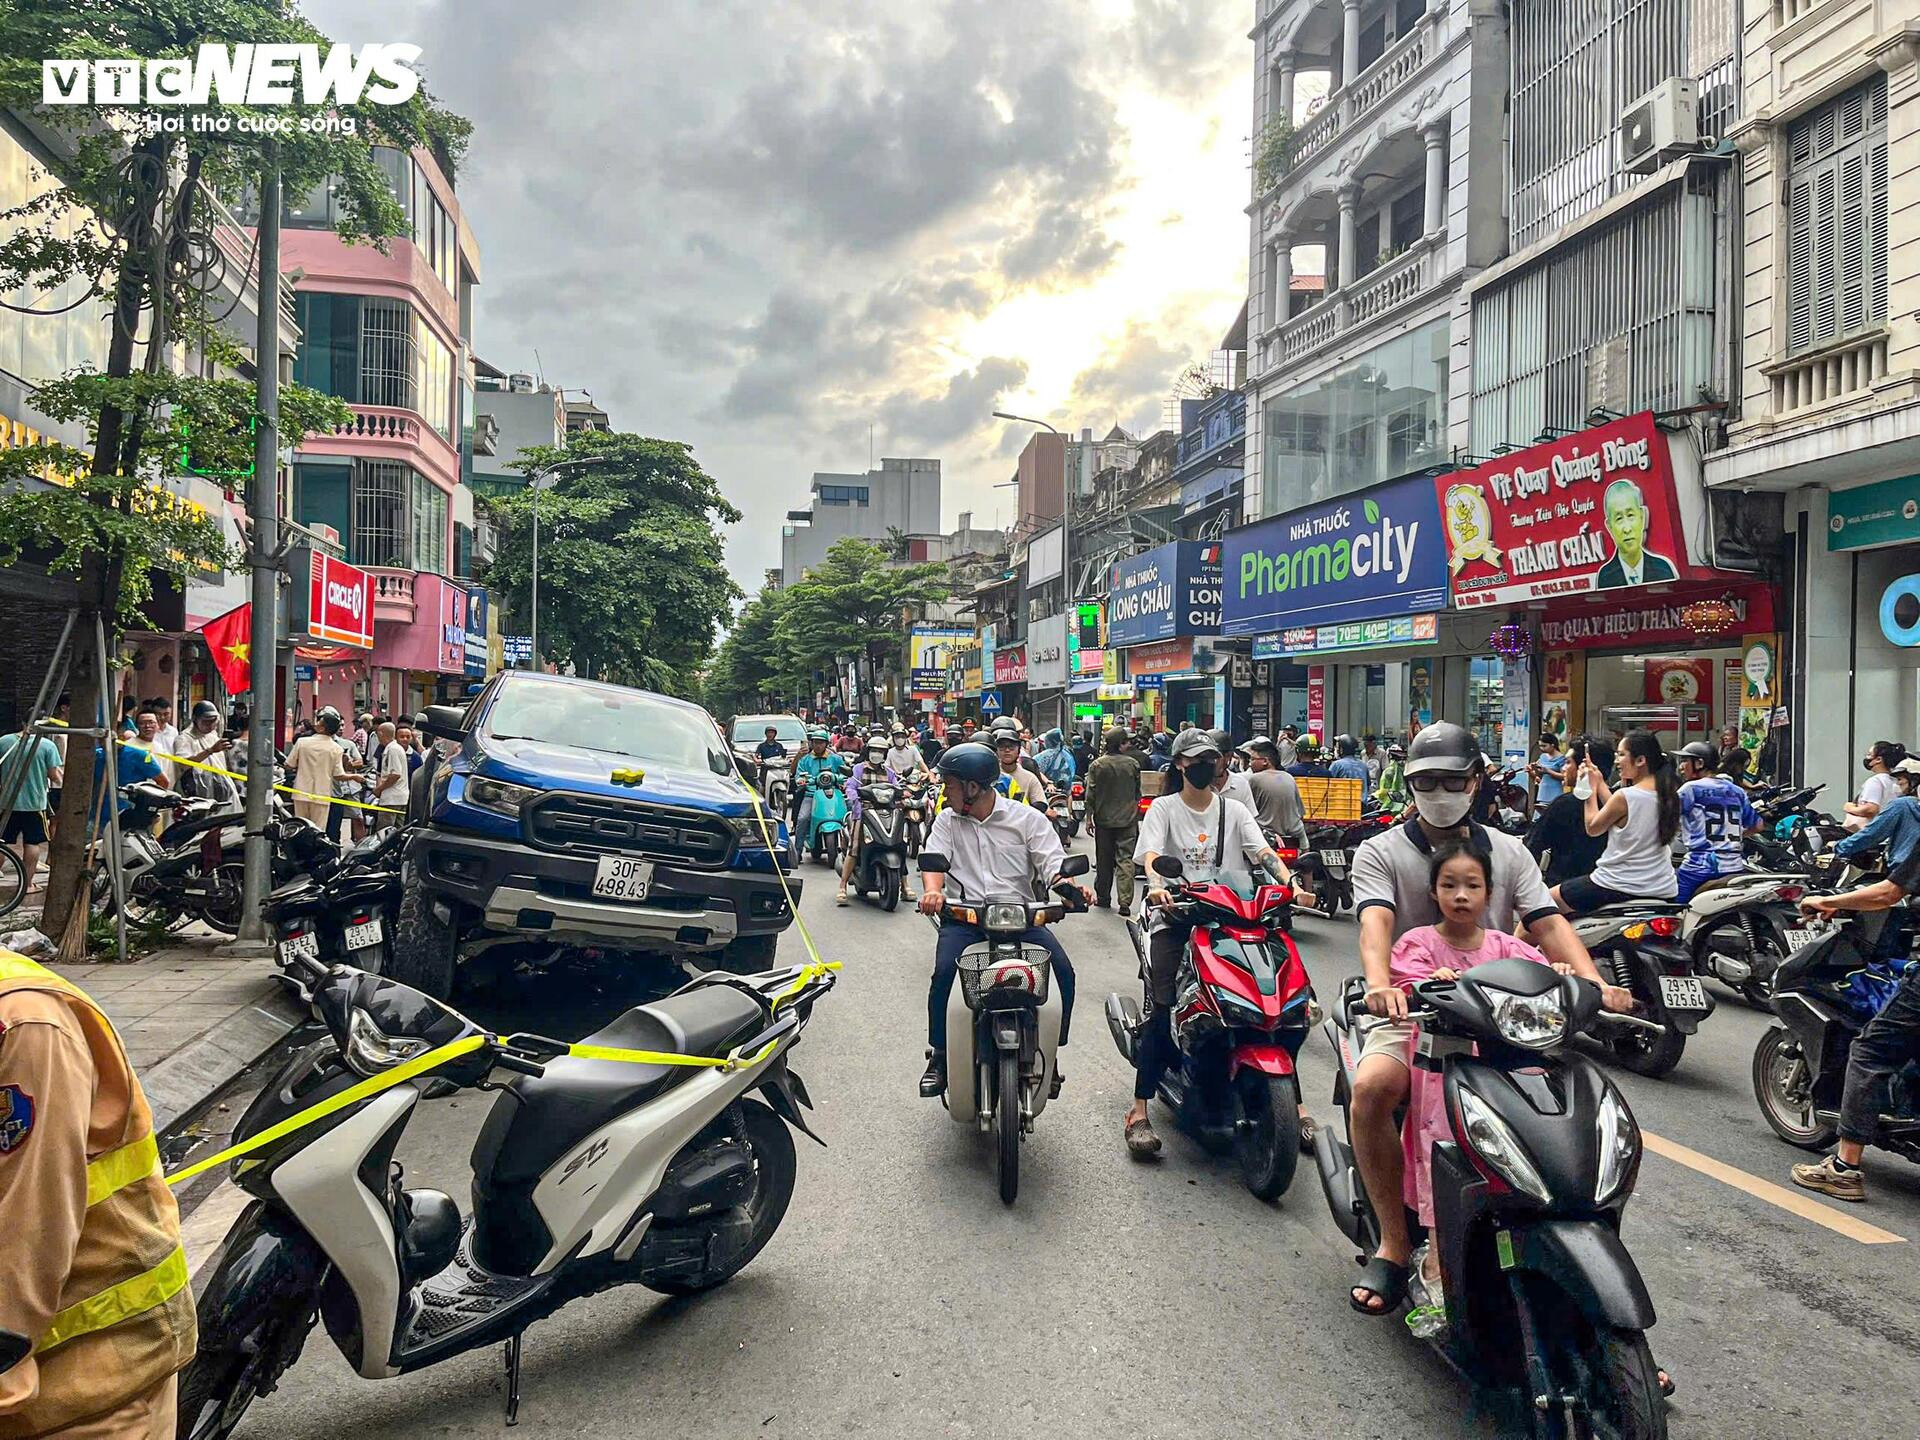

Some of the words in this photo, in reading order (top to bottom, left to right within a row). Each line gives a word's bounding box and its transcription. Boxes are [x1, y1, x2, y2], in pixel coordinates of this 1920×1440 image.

[1490, 473, 1513, 505] Vịt
[1514, 465, 1550, 499] Quay
[1552, 447, 1602, 488] Quảng
[1602, 437, 1649, 472] Đông
[1290, 517, 1312, 541] NHÀ
[1313, 506, 1350, 533] THUỐC
[1240, 515, 1419, 600] Pharmacity
[1508, 538, 1559, 576] THÀNH
[1560, 522, 1608, 568] CHẤN
[1124, 570, 1137, 589] NHÀ
[1137, 562, 1158, 585] THUỐC
[1189, 574, 1208, 585] NHÀ
[328, 581, 352, 609] CIRCLE
[1113, 594, 1138, 621] LONG
[1140, 581, 1171, 615] CHÂU
[1563, 617, 1601, 643] QUAY
[1604, 608, 1639, 639] HIỆU
[540, 811, 722, 848] FORD
[1706, 804, 1742, 842] 25
[611, 859, 642, 880] 30F
[595, 876, 646, 899] 498.43
[350, 922, 374, 938] 29-Y5
[1666, 979, 1698, 993] 29-Y5
[1666, 993, 1705, 1008] 925.64
